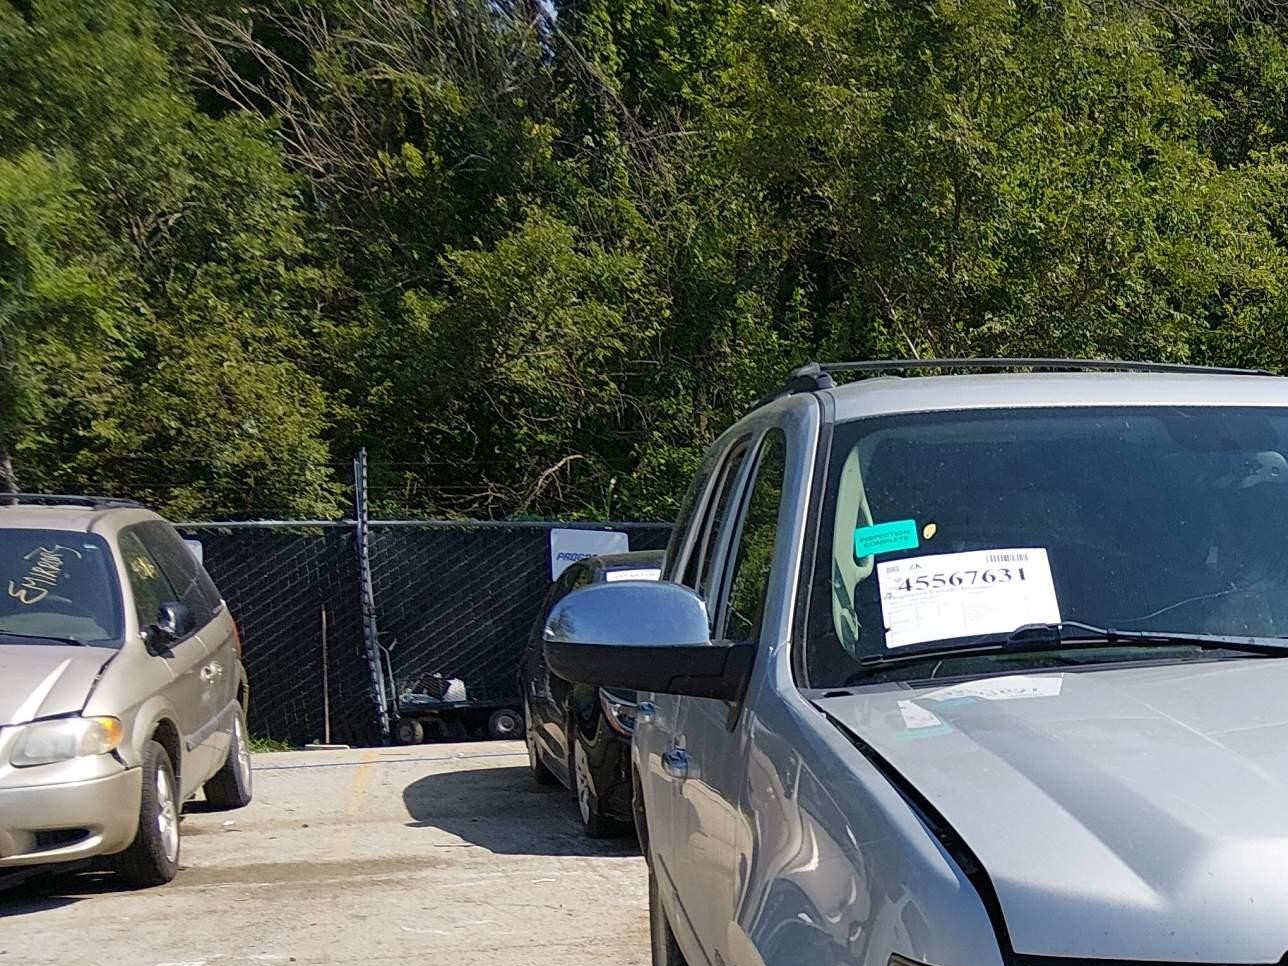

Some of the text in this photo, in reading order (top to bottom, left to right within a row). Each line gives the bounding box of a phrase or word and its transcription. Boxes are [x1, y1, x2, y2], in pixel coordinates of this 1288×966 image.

[859, 530, 910, 543] INSPECTION
[864, 536, 909, 548] COMPLETE
[898, 567, 1027, 592] 45567631
